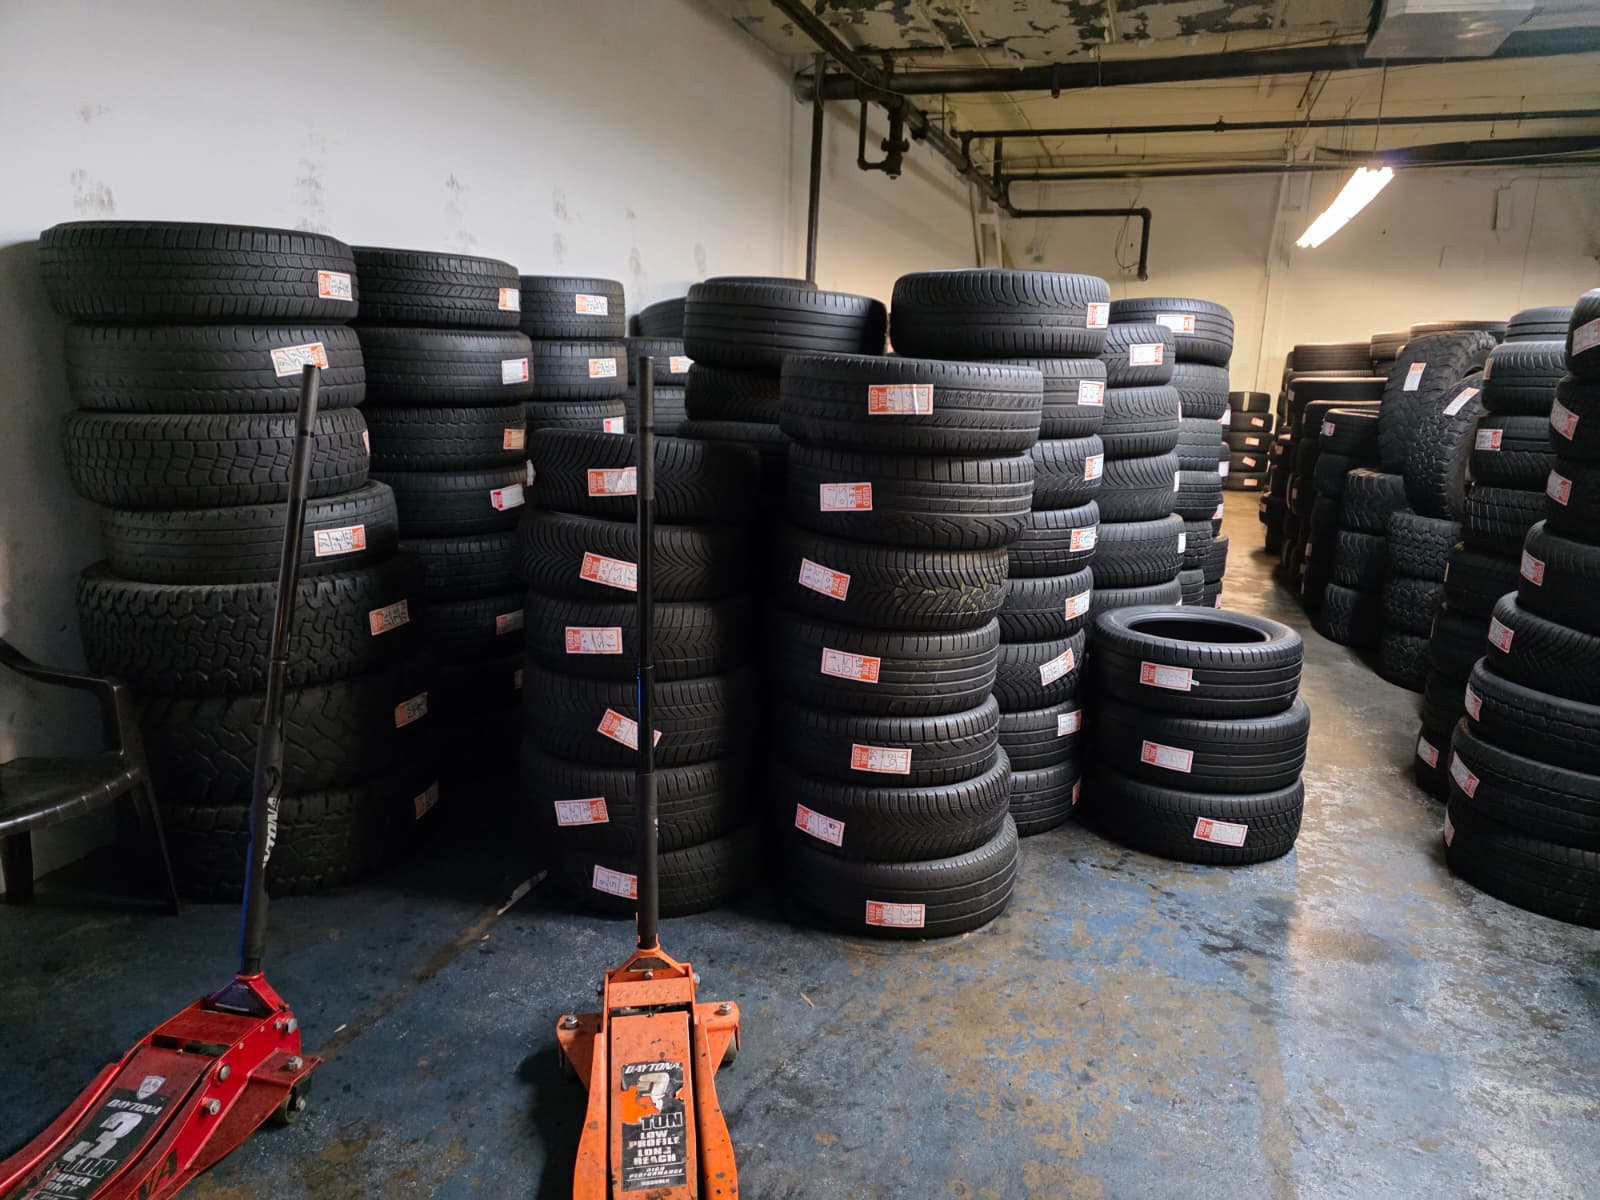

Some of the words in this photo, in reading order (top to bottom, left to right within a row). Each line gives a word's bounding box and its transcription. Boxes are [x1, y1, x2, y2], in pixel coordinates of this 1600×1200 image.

[584, 557, 592, 575] USED
[832, 579, 840, 592] TIRE
[839, 578, 847, 596] USED
[602, 714, 613, 729] USED
[262, 796, 280, 869] AYTONA
[625, 1062, 681, 1074] DAYTONA
[107, 1099, 162, 1115] DAYTONA
[641, 1112, 683, 1130] TON
[62, 1111, 142, 1161] 3
[628, 1136, 680, 1149] PROFILE
[640, 1130, 668, 1140] LOW
[633, 1154, 677, 1165] REACH
[62, 1158, 117, 1178] TON
[50, 1172, 91, 1187] SUPER
